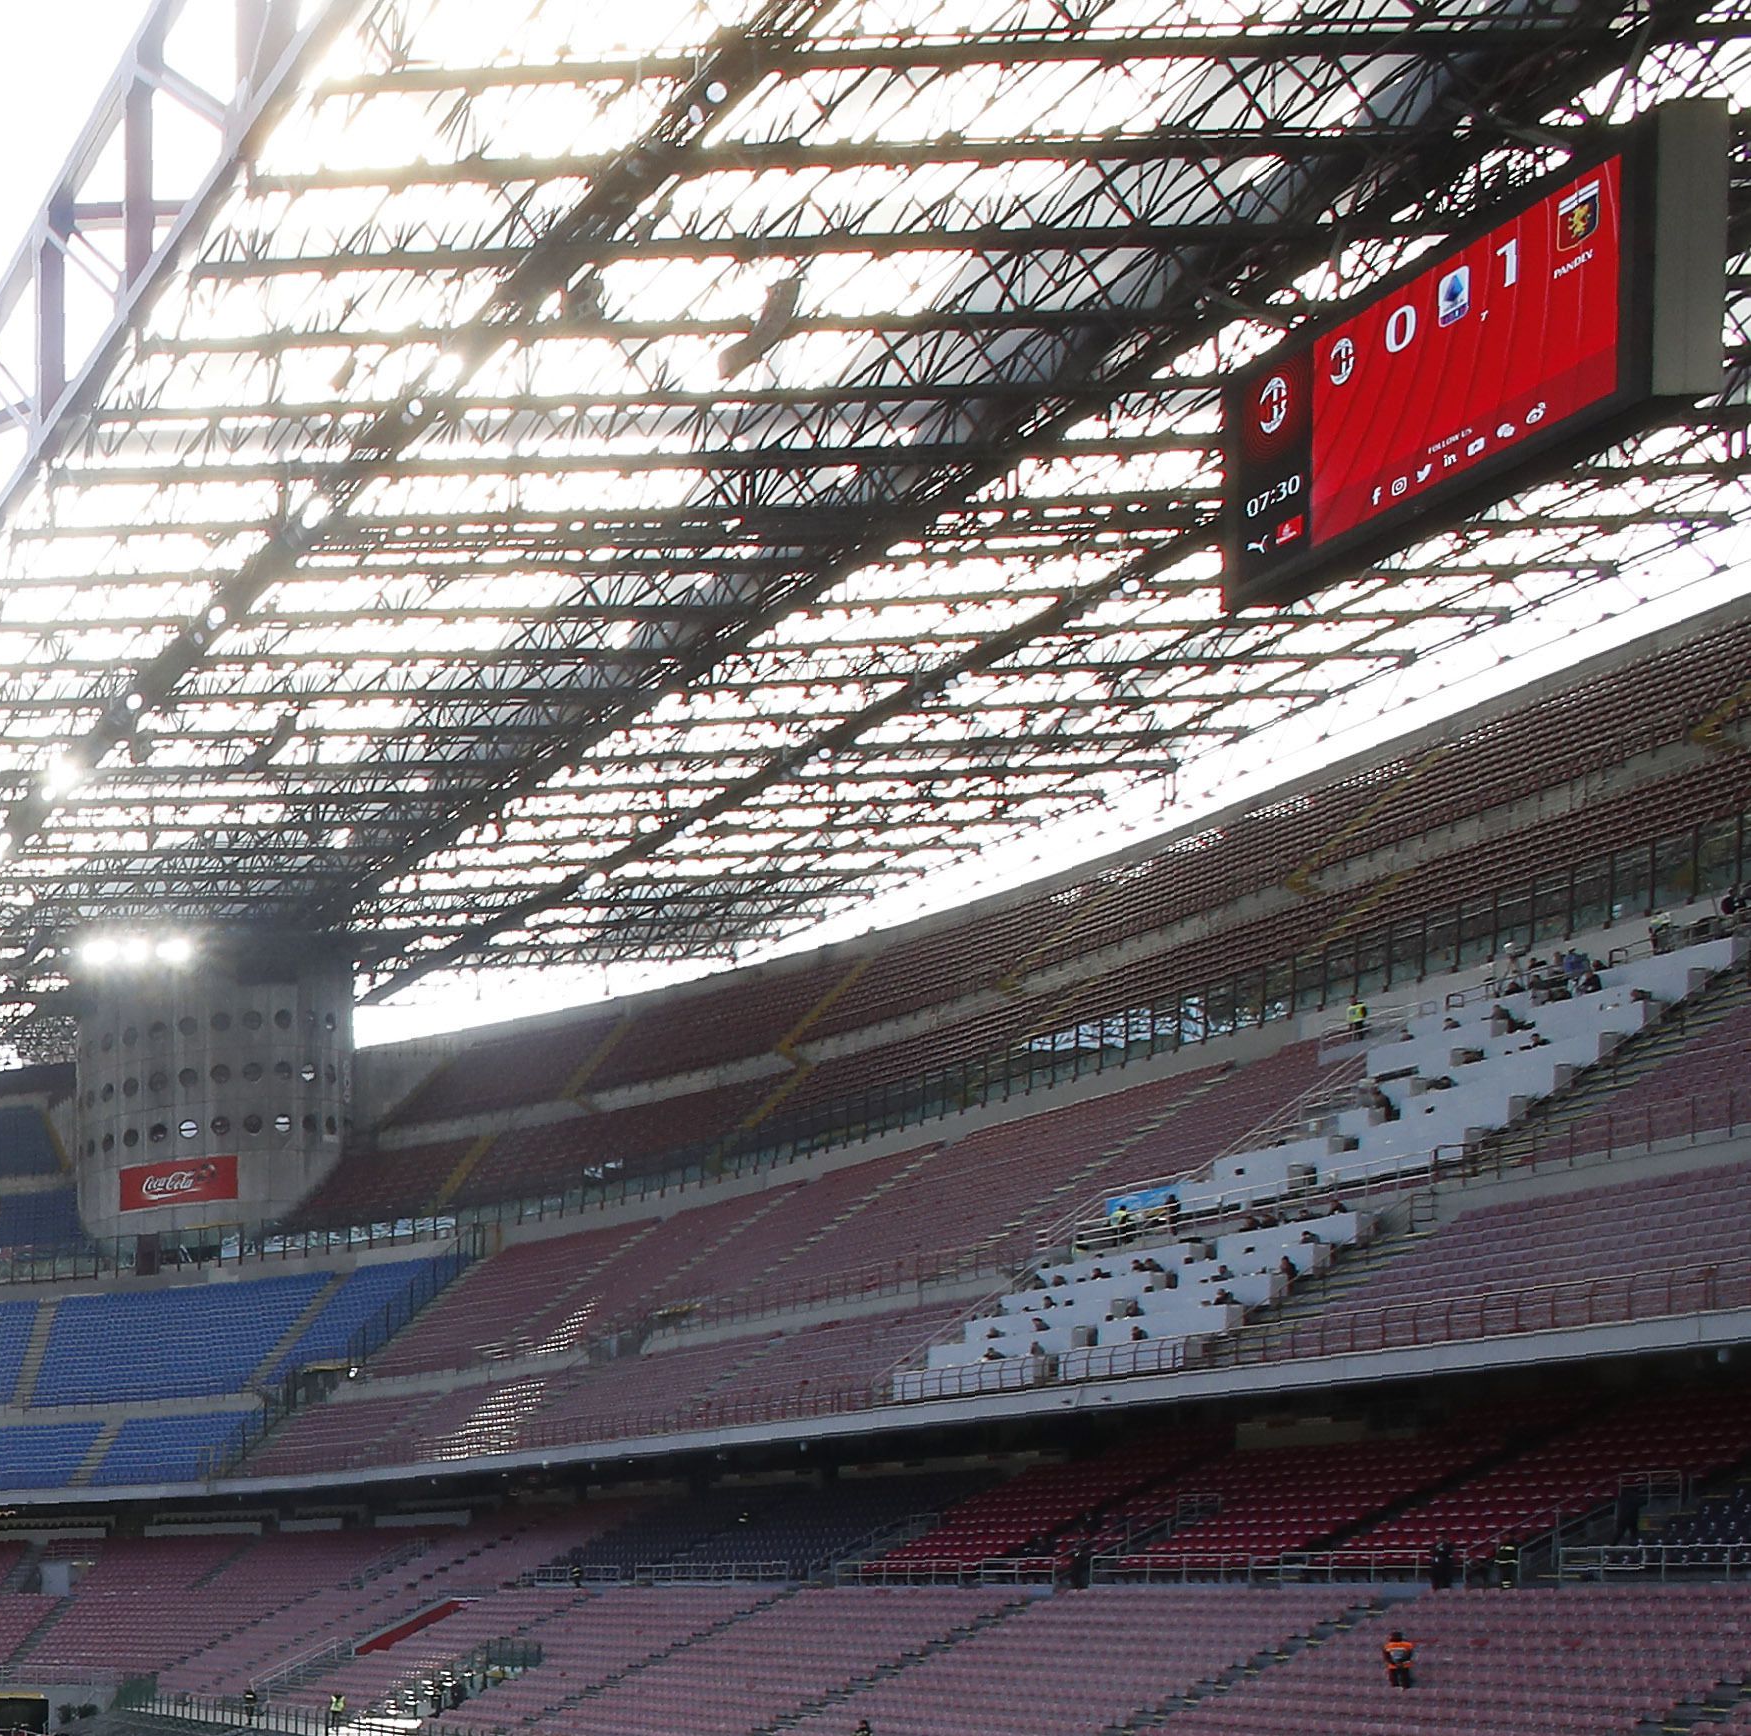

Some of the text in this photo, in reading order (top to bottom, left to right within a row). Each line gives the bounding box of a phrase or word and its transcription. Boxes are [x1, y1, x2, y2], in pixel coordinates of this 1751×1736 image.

[1496, 238, 1518, 287] 1
[1553, 249, 1593, 279] PANDEV
[1385, 305, 1417, 353] 0
[1246, 475, 1301, 518] 07:30
[142, 1171, 199, 1200] Coca-Cola
